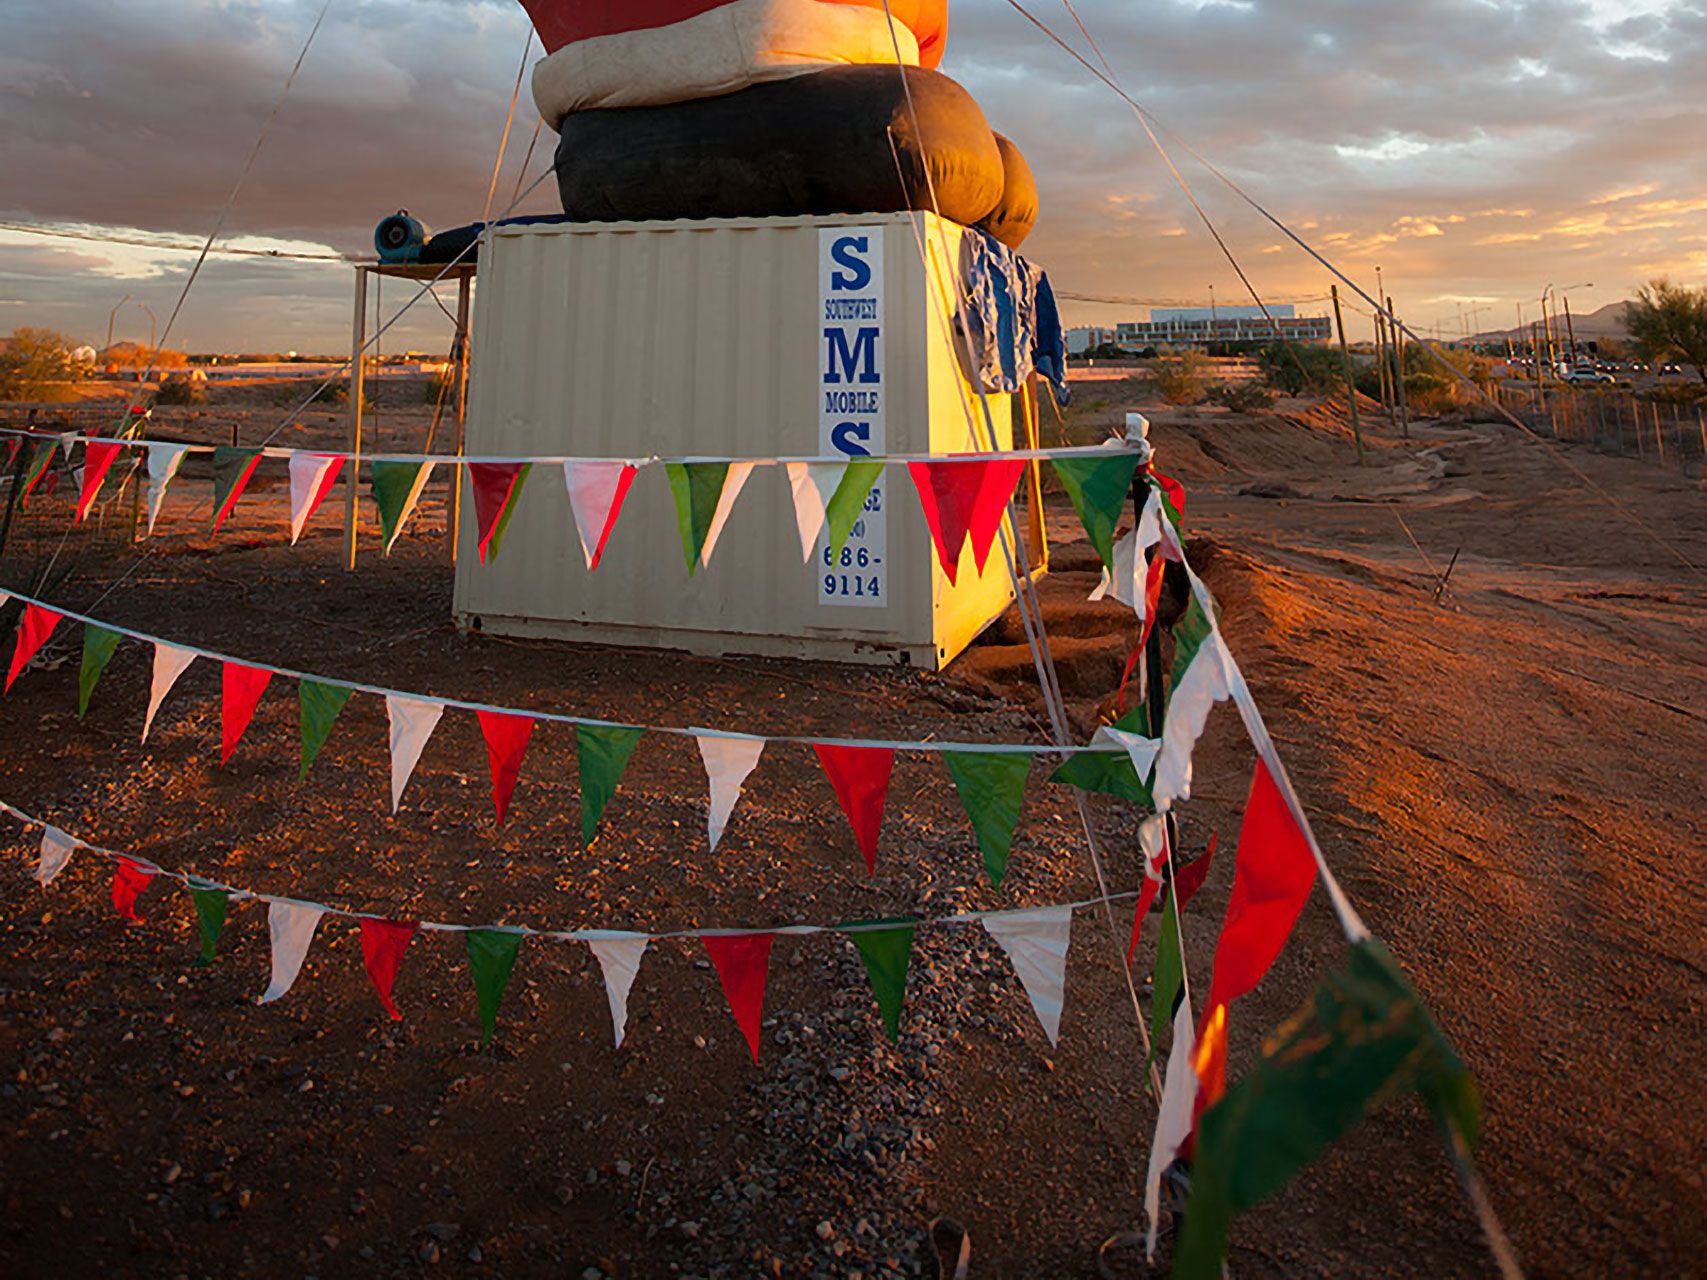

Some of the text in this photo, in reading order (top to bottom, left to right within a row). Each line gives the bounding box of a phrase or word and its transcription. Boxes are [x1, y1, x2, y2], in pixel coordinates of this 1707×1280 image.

[831, 236, 871, 291] S
[825, 298, 877, 319] SOUTHWEST
[824, 327, 880, 384] M
[826, 392, 878, 413] MOBILE
[824, 574, 880, 597] 9114
